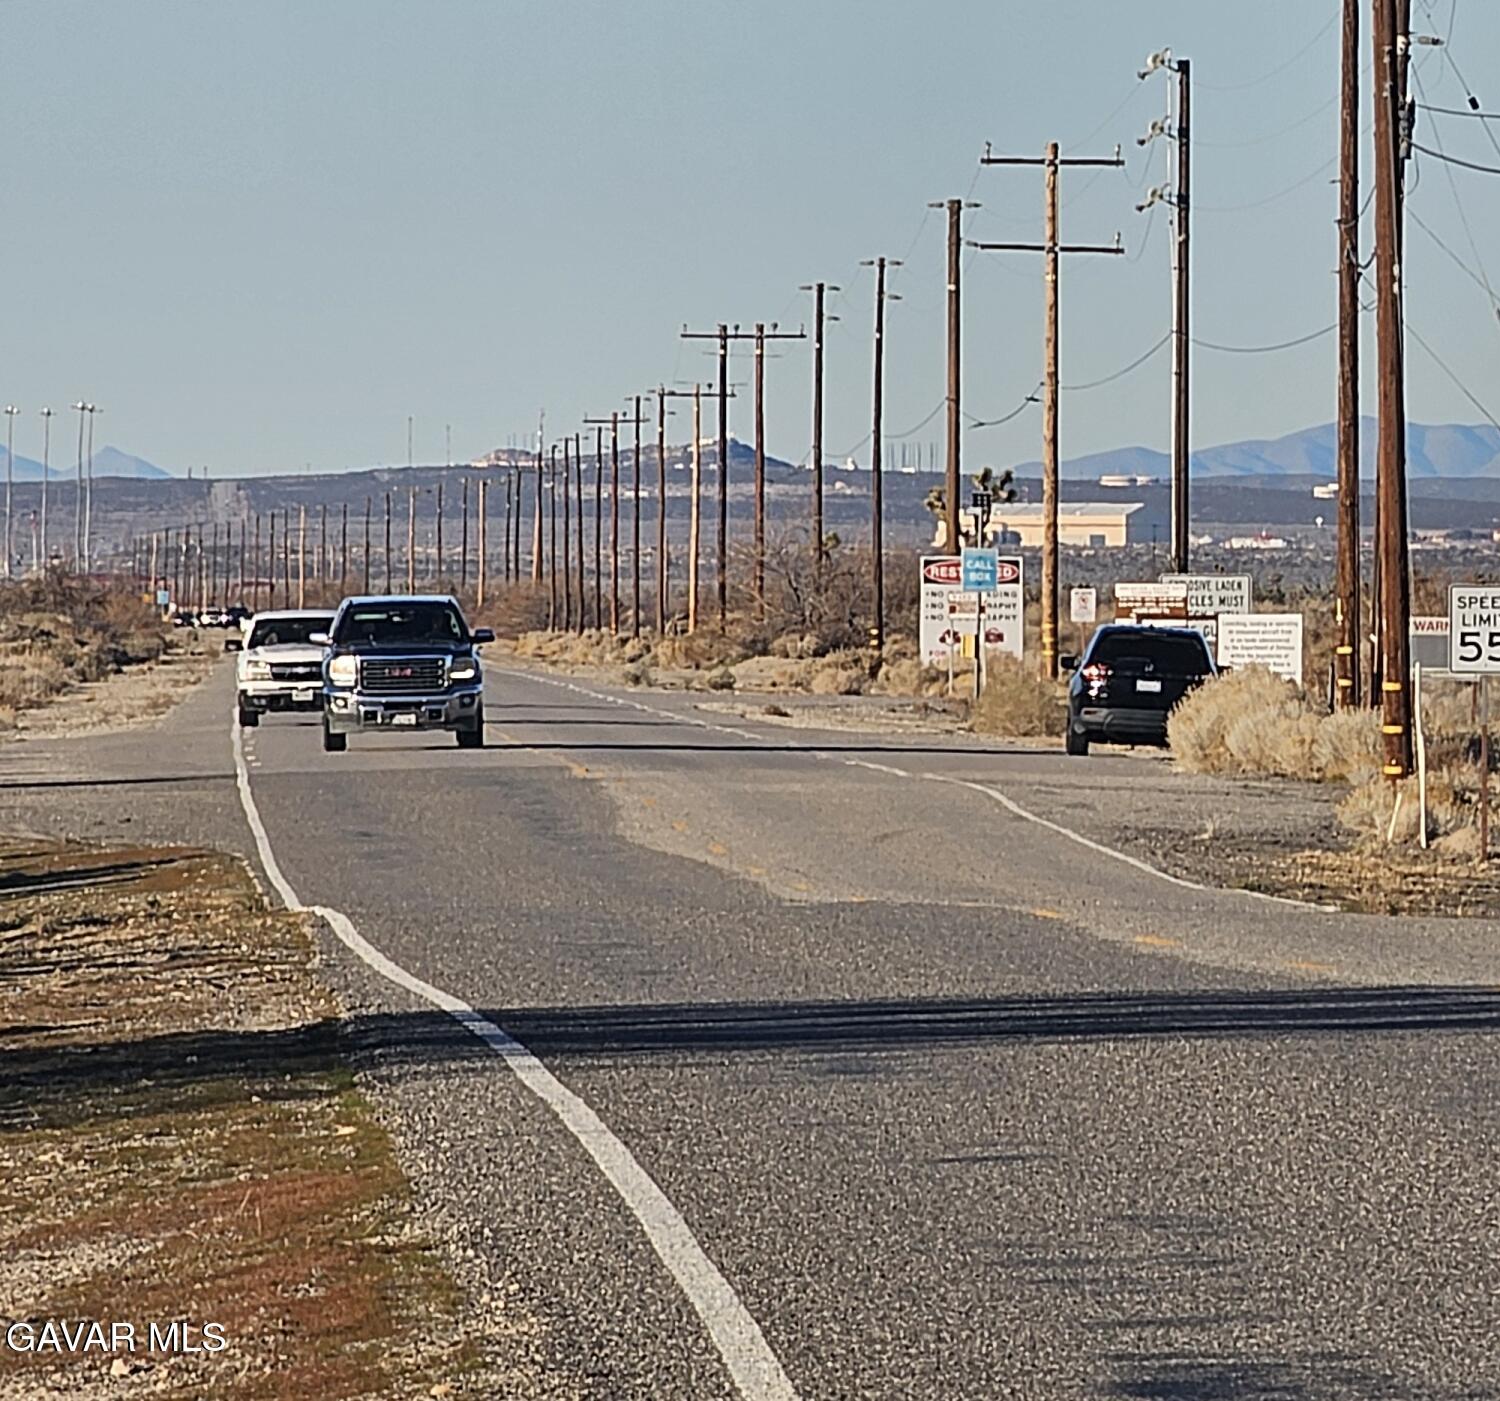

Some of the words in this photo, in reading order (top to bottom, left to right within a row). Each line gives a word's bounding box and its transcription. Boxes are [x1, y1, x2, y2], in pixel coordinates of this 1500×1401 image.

[966, 560, 994, 569] CALL
[969, 572, 992, 582] BOX
[1215, 580, 1243, 591] LADEN
[1219, 595, 1244, 607] MUST
